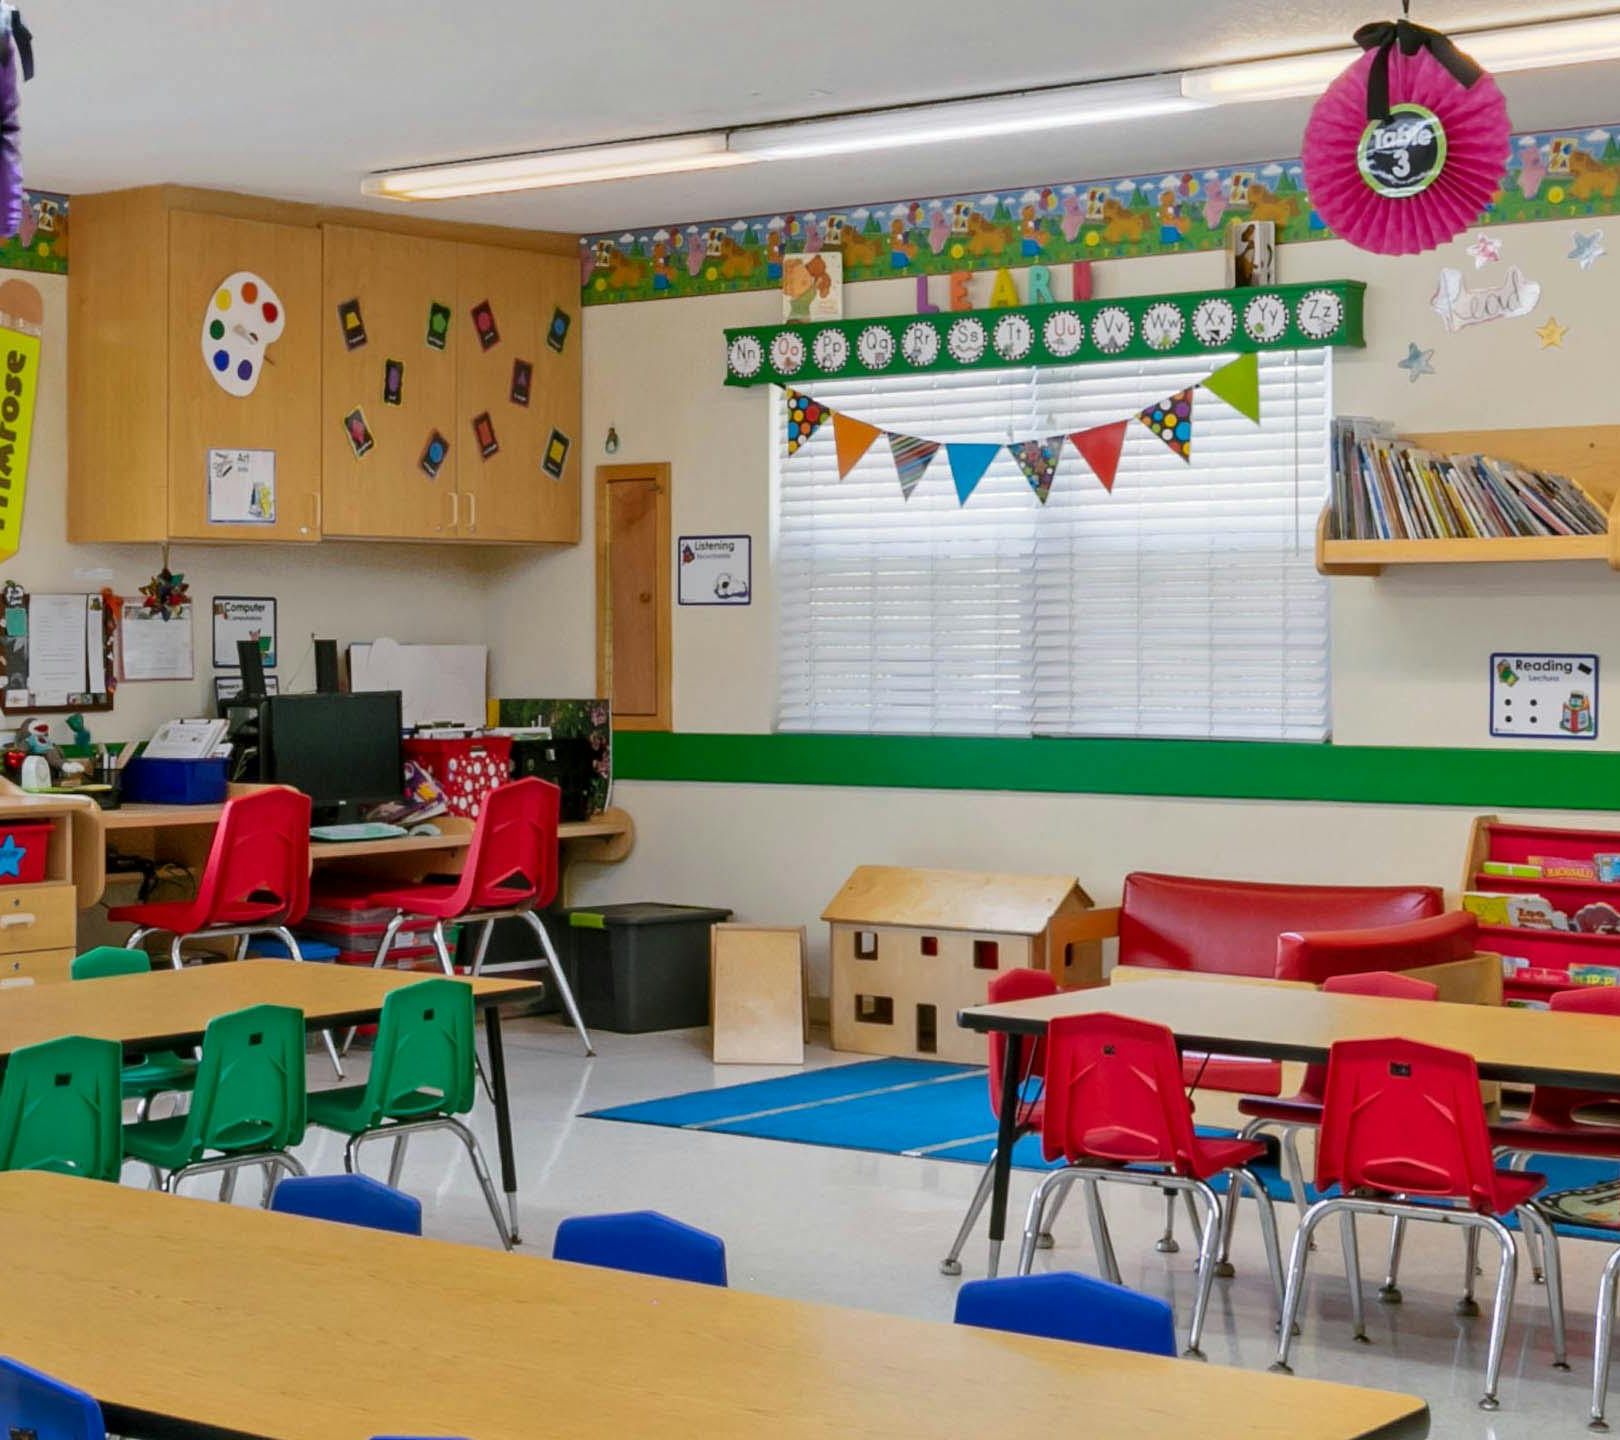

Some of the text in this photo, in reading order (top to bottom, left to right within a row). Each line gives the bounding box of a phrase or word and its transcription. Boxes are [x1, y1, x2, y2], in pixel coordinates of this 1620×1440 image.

[1371, 121, 1433, 150] Table
[1392, 149, 1411, 178] 3
[736, 298, 1333, 359] Nn Oo Pp Qq Rr Ss Tt Uu Vv Ww Xx Yy Zz
[694, 540, 735, 552] Listening
[224, 601, 265, 615] Computer
[1515, 659, 1573, 675] Reading
